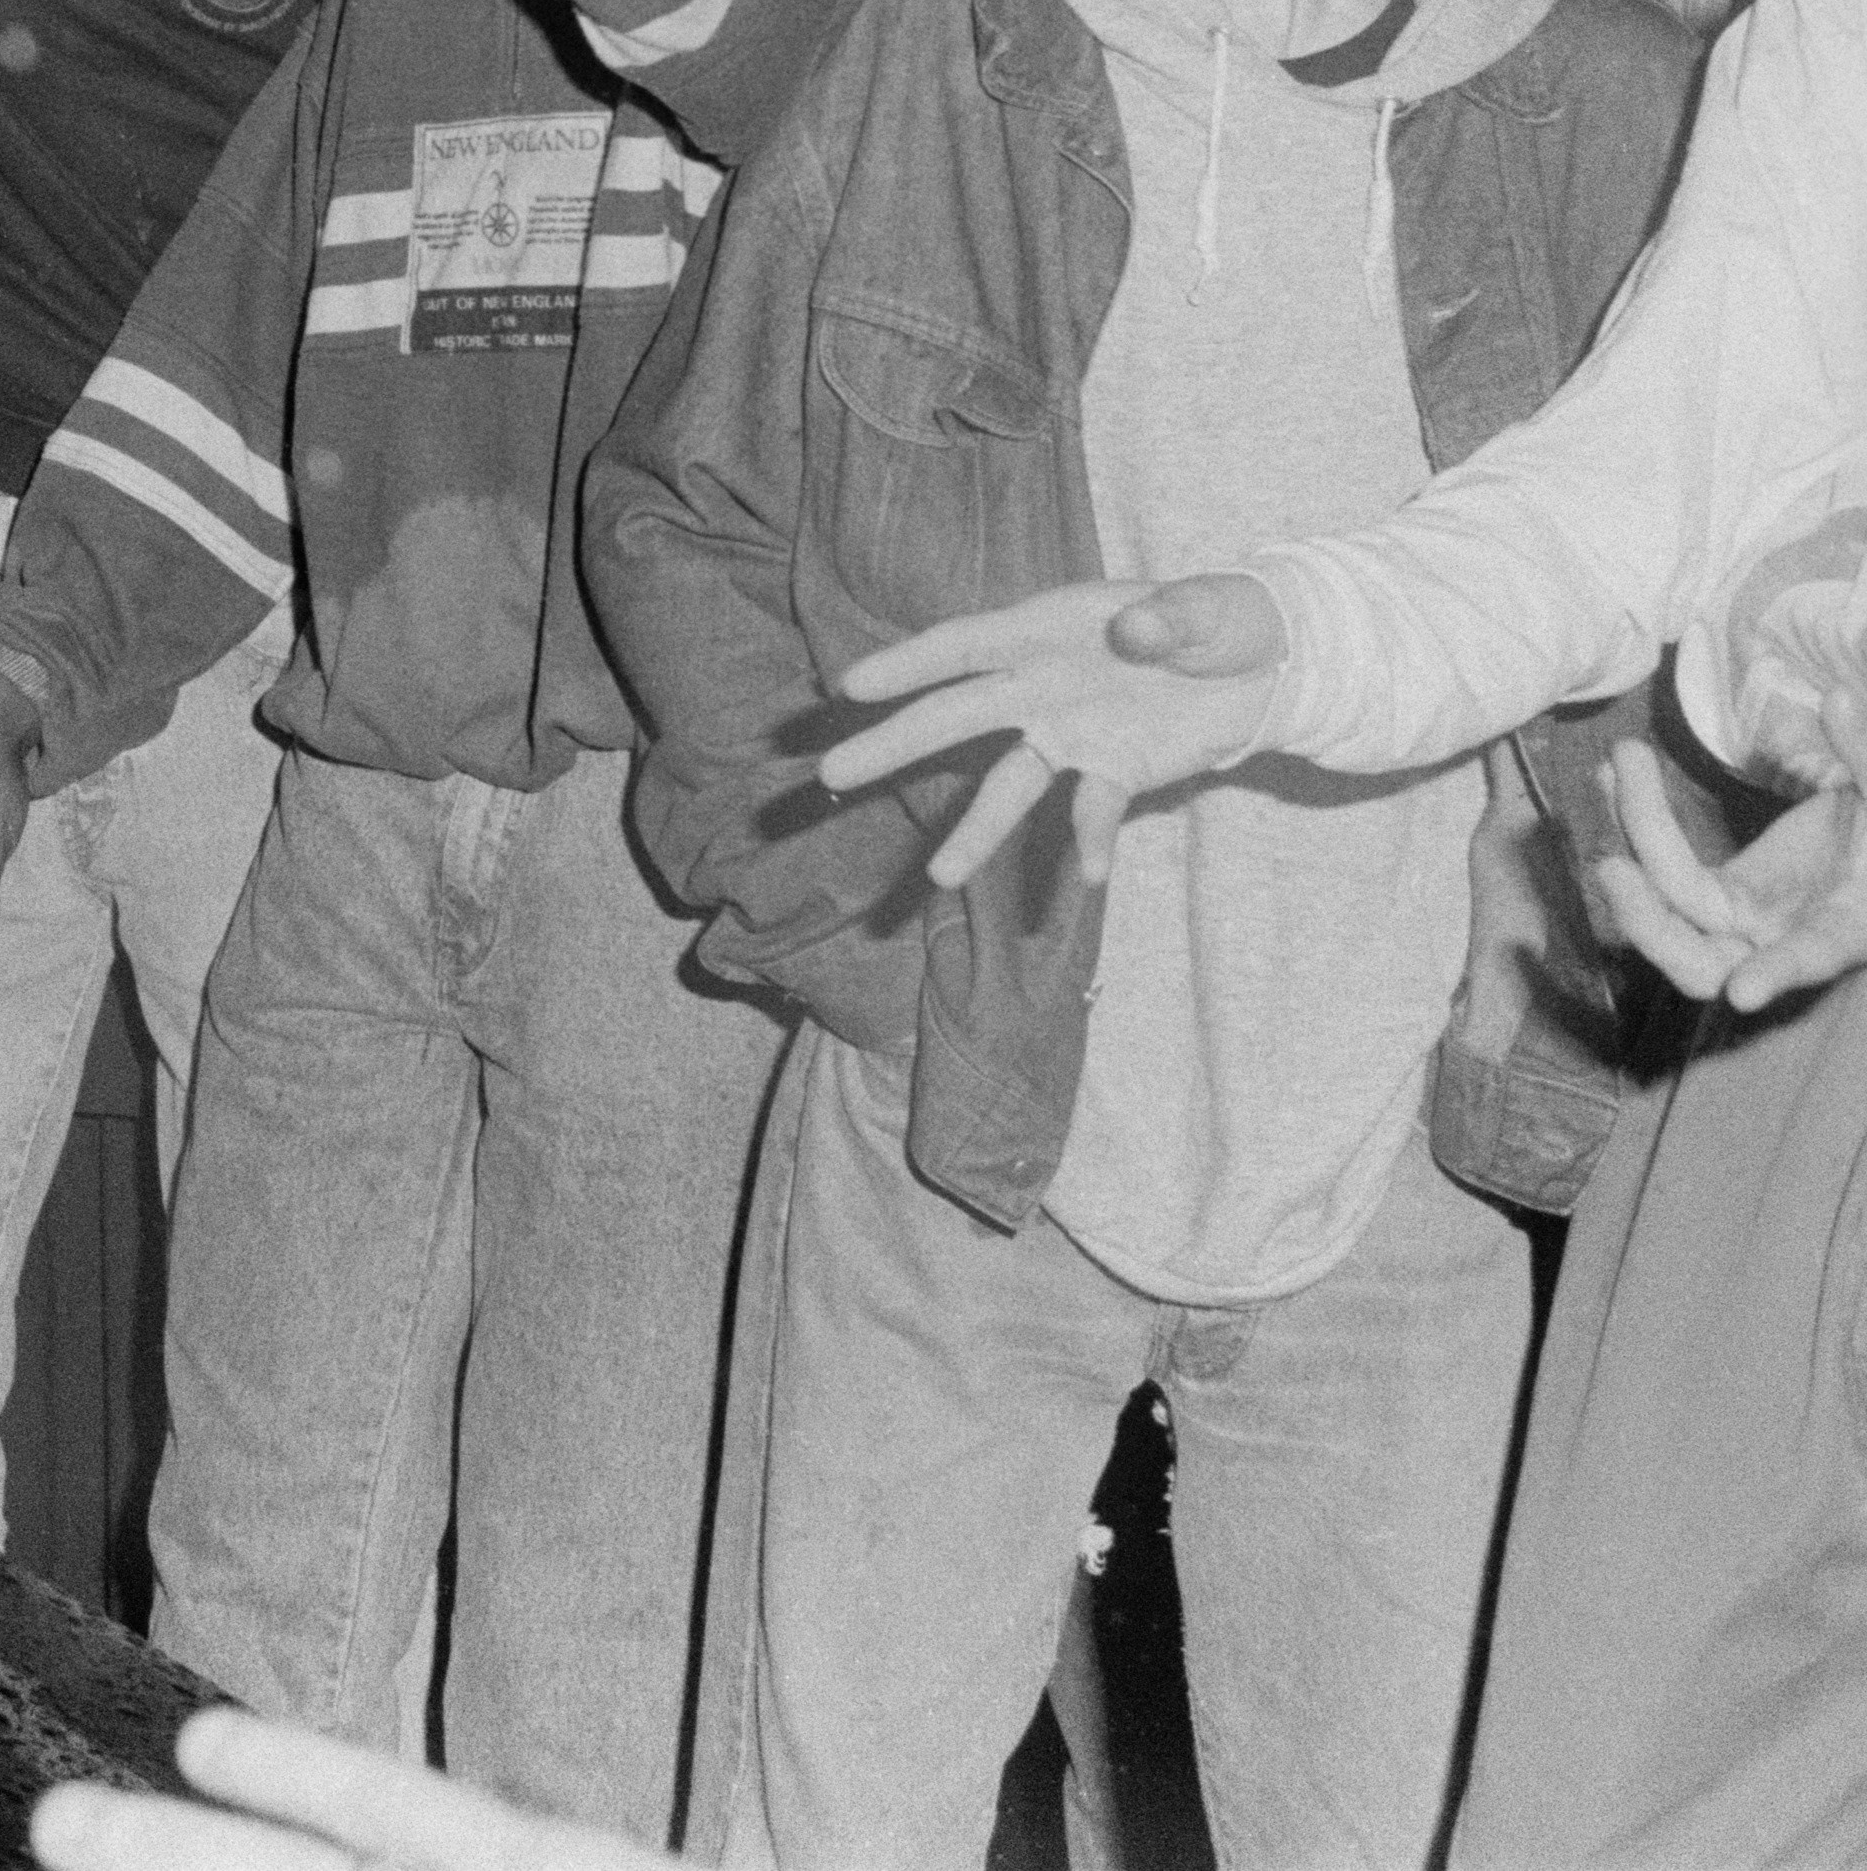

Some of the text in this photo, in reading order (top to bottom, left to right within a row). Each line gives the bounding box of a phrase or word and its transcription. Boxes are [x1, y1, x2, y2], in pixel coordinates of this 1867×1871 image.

[429, 128, 601, 161] NEW ENGLAND
[512, 294, 576, 309] ENGLAN
